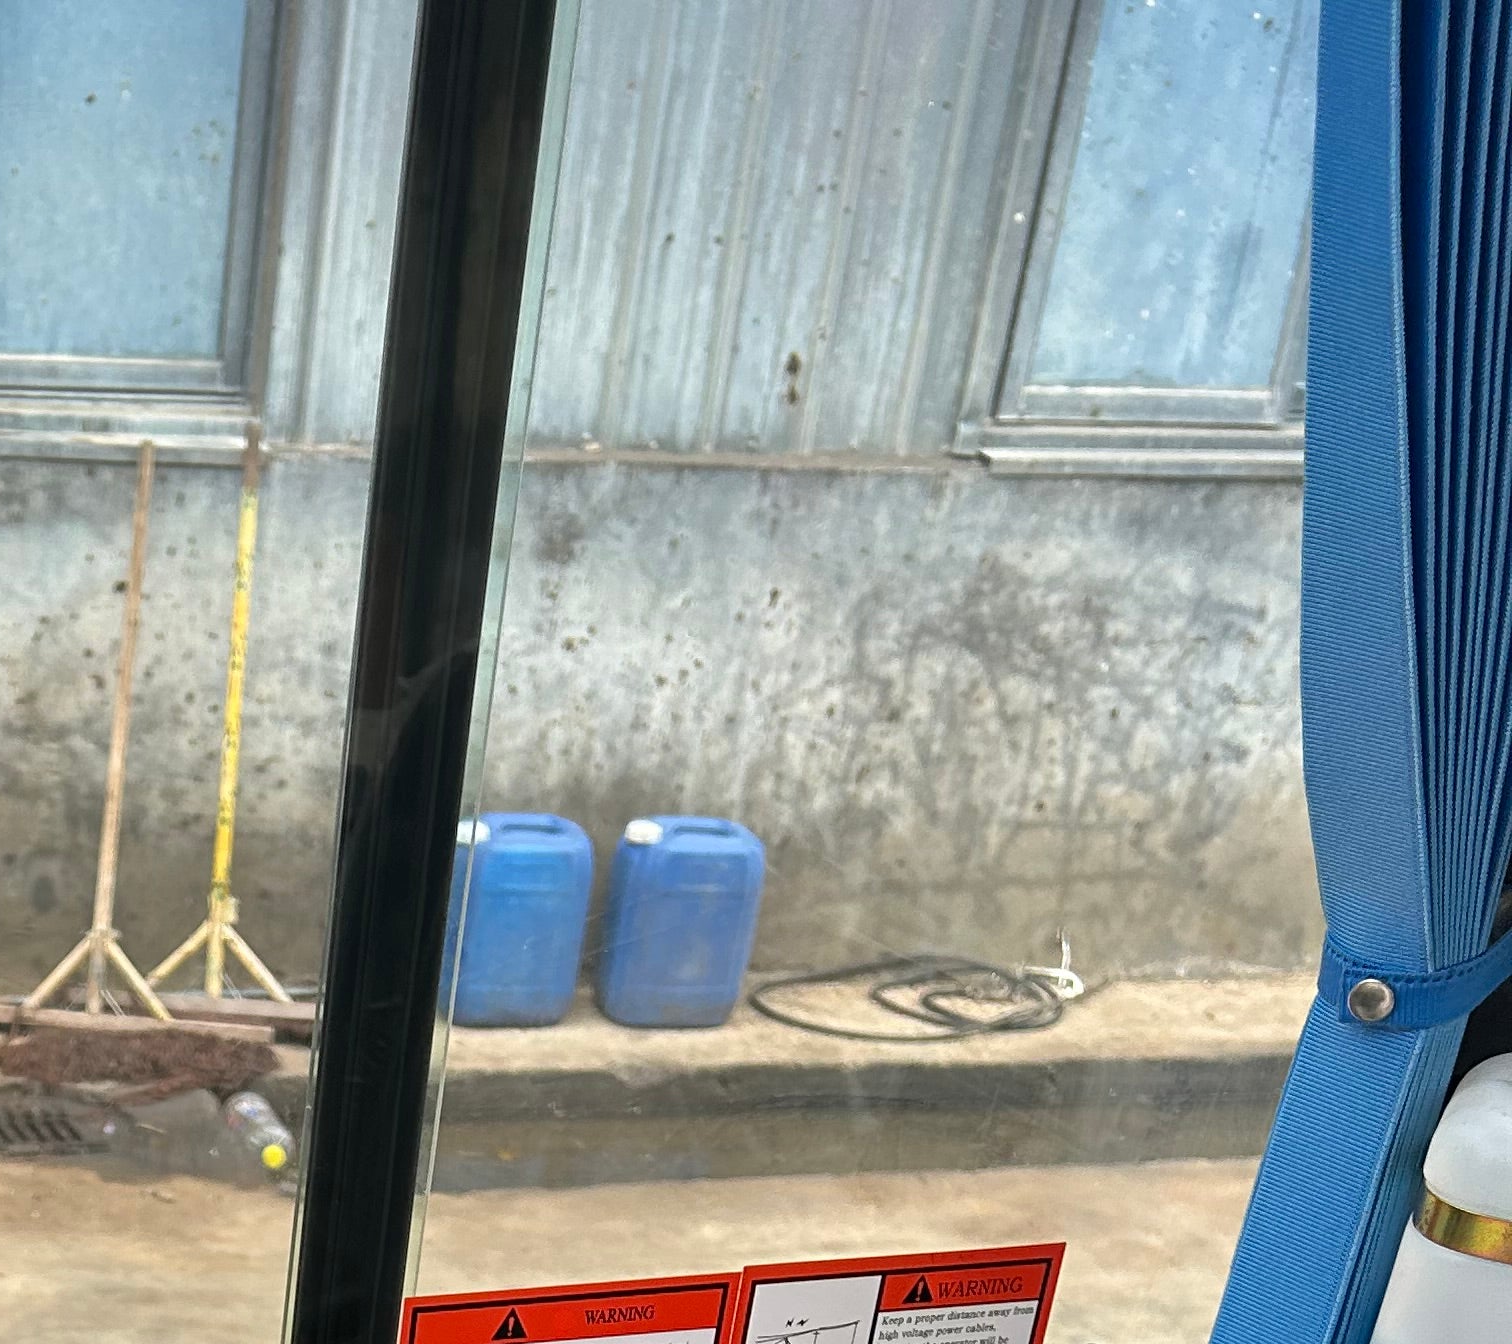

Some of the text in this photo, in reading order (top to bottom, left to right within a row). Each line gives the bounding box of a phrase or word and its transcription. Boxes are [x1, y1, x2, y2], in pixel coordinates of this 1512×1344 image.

[938, 1276, 1023, 1299] WARNING
[585, 1305, 655, 1325] WARNING
[881, 1316, 904, 1326] Keep
[914, 1314, 945, 1325] proper
[947, 1311, 985, 1320] distance
[987, 1309, 1011, 1317] away
[1013, 1306, 1034, 1315] from
[878, 1330, 898, 1341] high
[902, 1328, 934, 1337] voltage
[935, 1327, 963, 1337] power
[980, 1336, 995, 1344] will
[998, 1336, 1009, 1344] be
